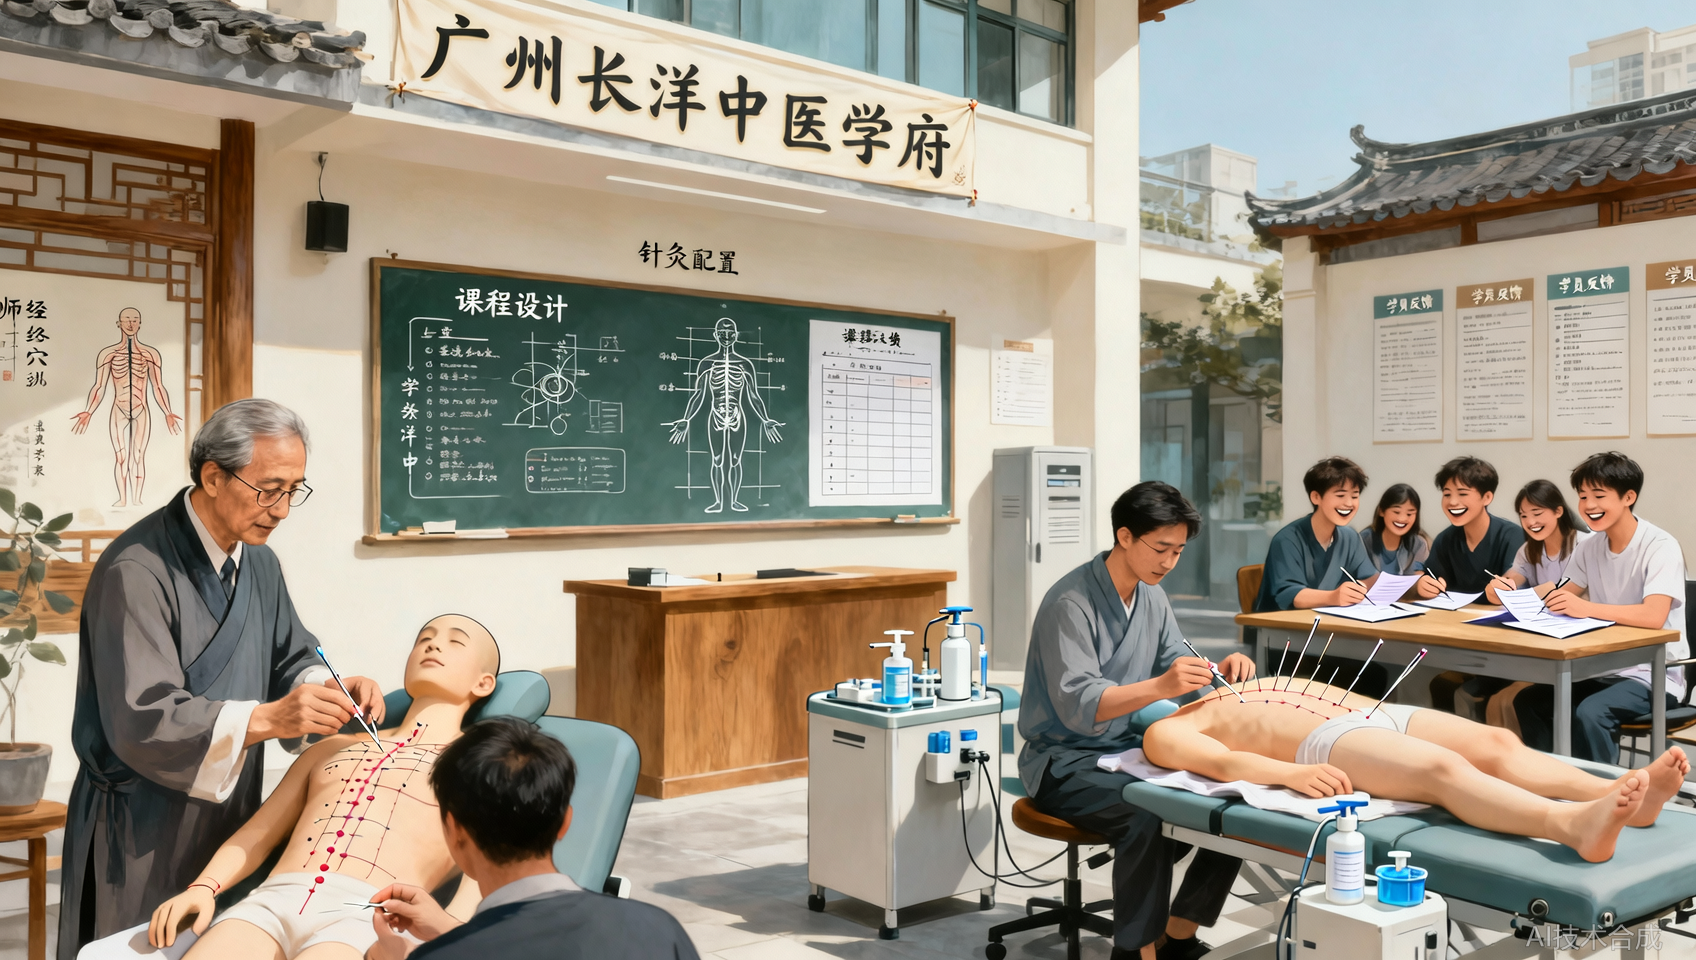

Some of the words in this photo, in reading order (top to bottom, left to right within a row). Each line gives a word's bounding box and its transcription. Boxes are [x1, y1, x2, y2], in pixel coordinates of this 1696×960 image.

[421, 14, 951, 179] 广州长洋中医学府
[638, 240, 739, 275] 针灸配置
[455, 287, 568, 323] 课程设计
